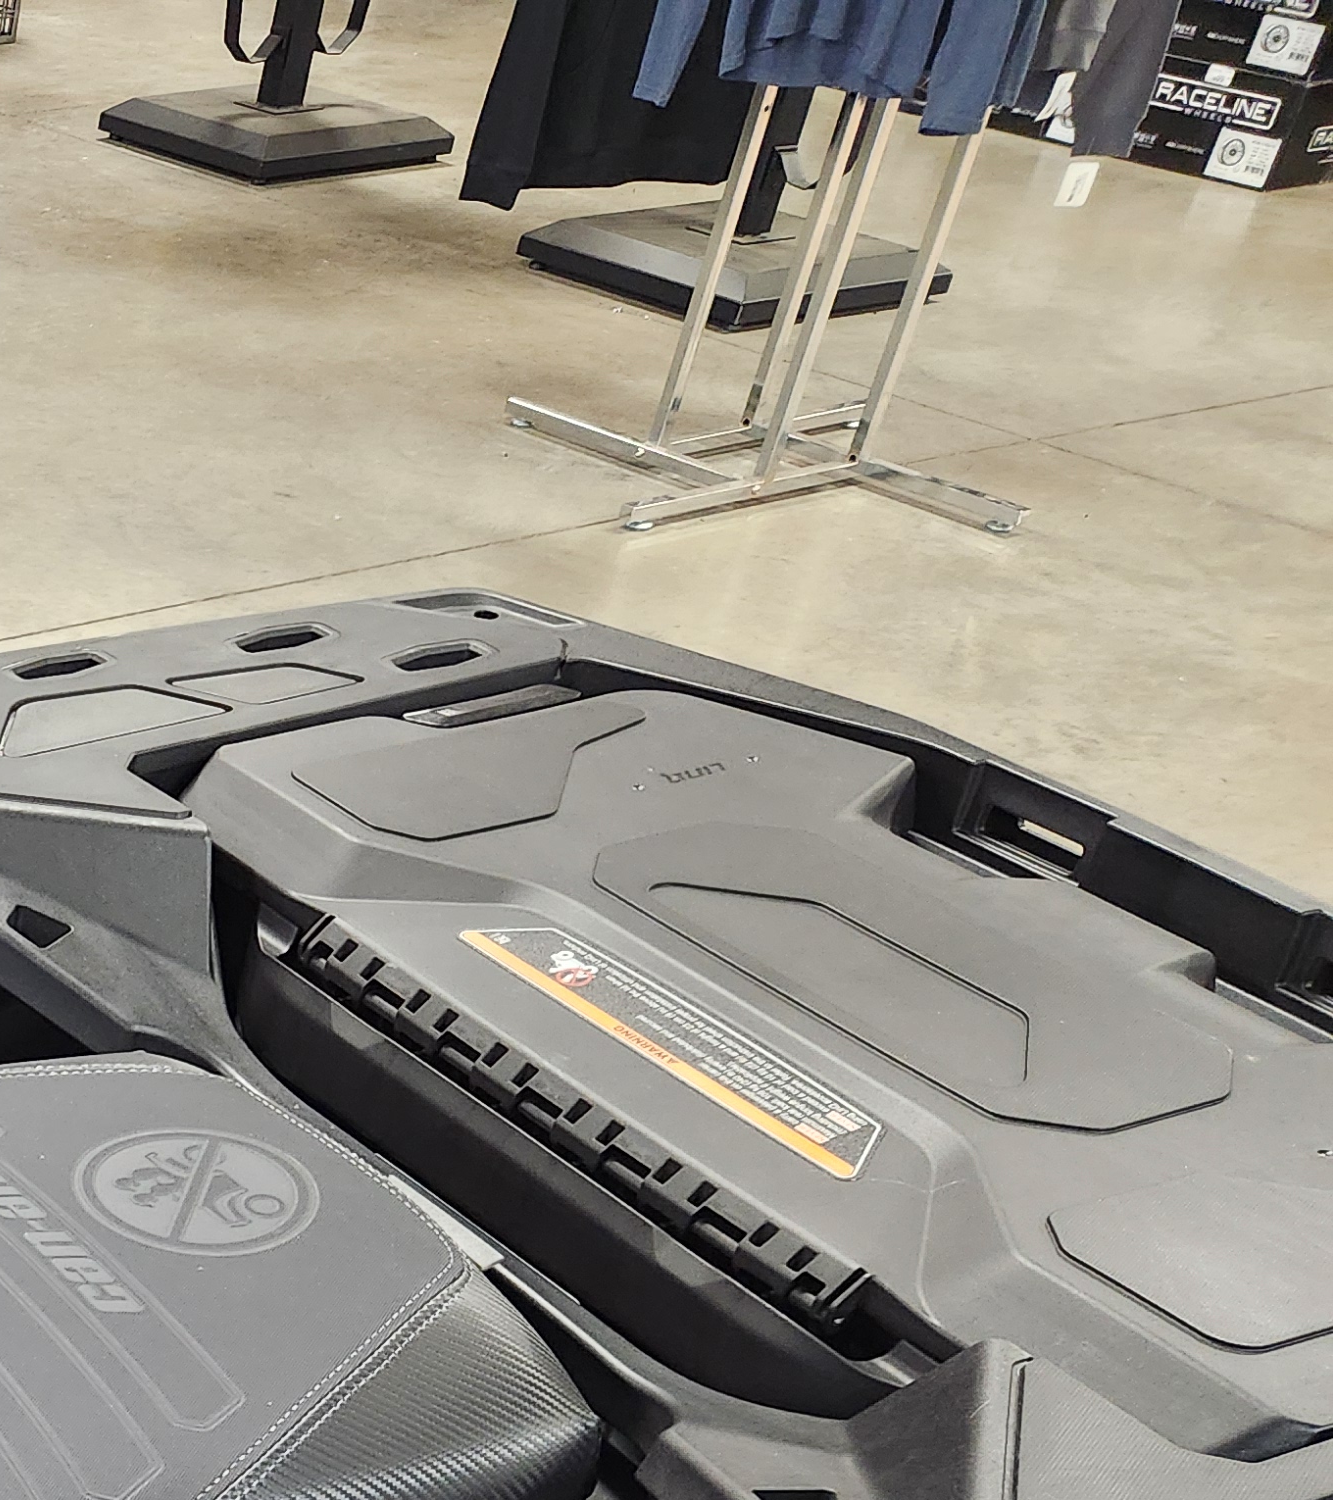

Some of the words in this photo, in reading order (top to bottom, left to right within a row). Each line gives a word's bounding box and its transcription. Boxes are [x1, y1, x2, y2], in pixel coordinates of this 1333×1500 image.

[1155, 81, 1272, 122] RACELINE
[1184, 107, 1232, 124] WHEELS
[613, 1024, 669, 1060] WARNING
